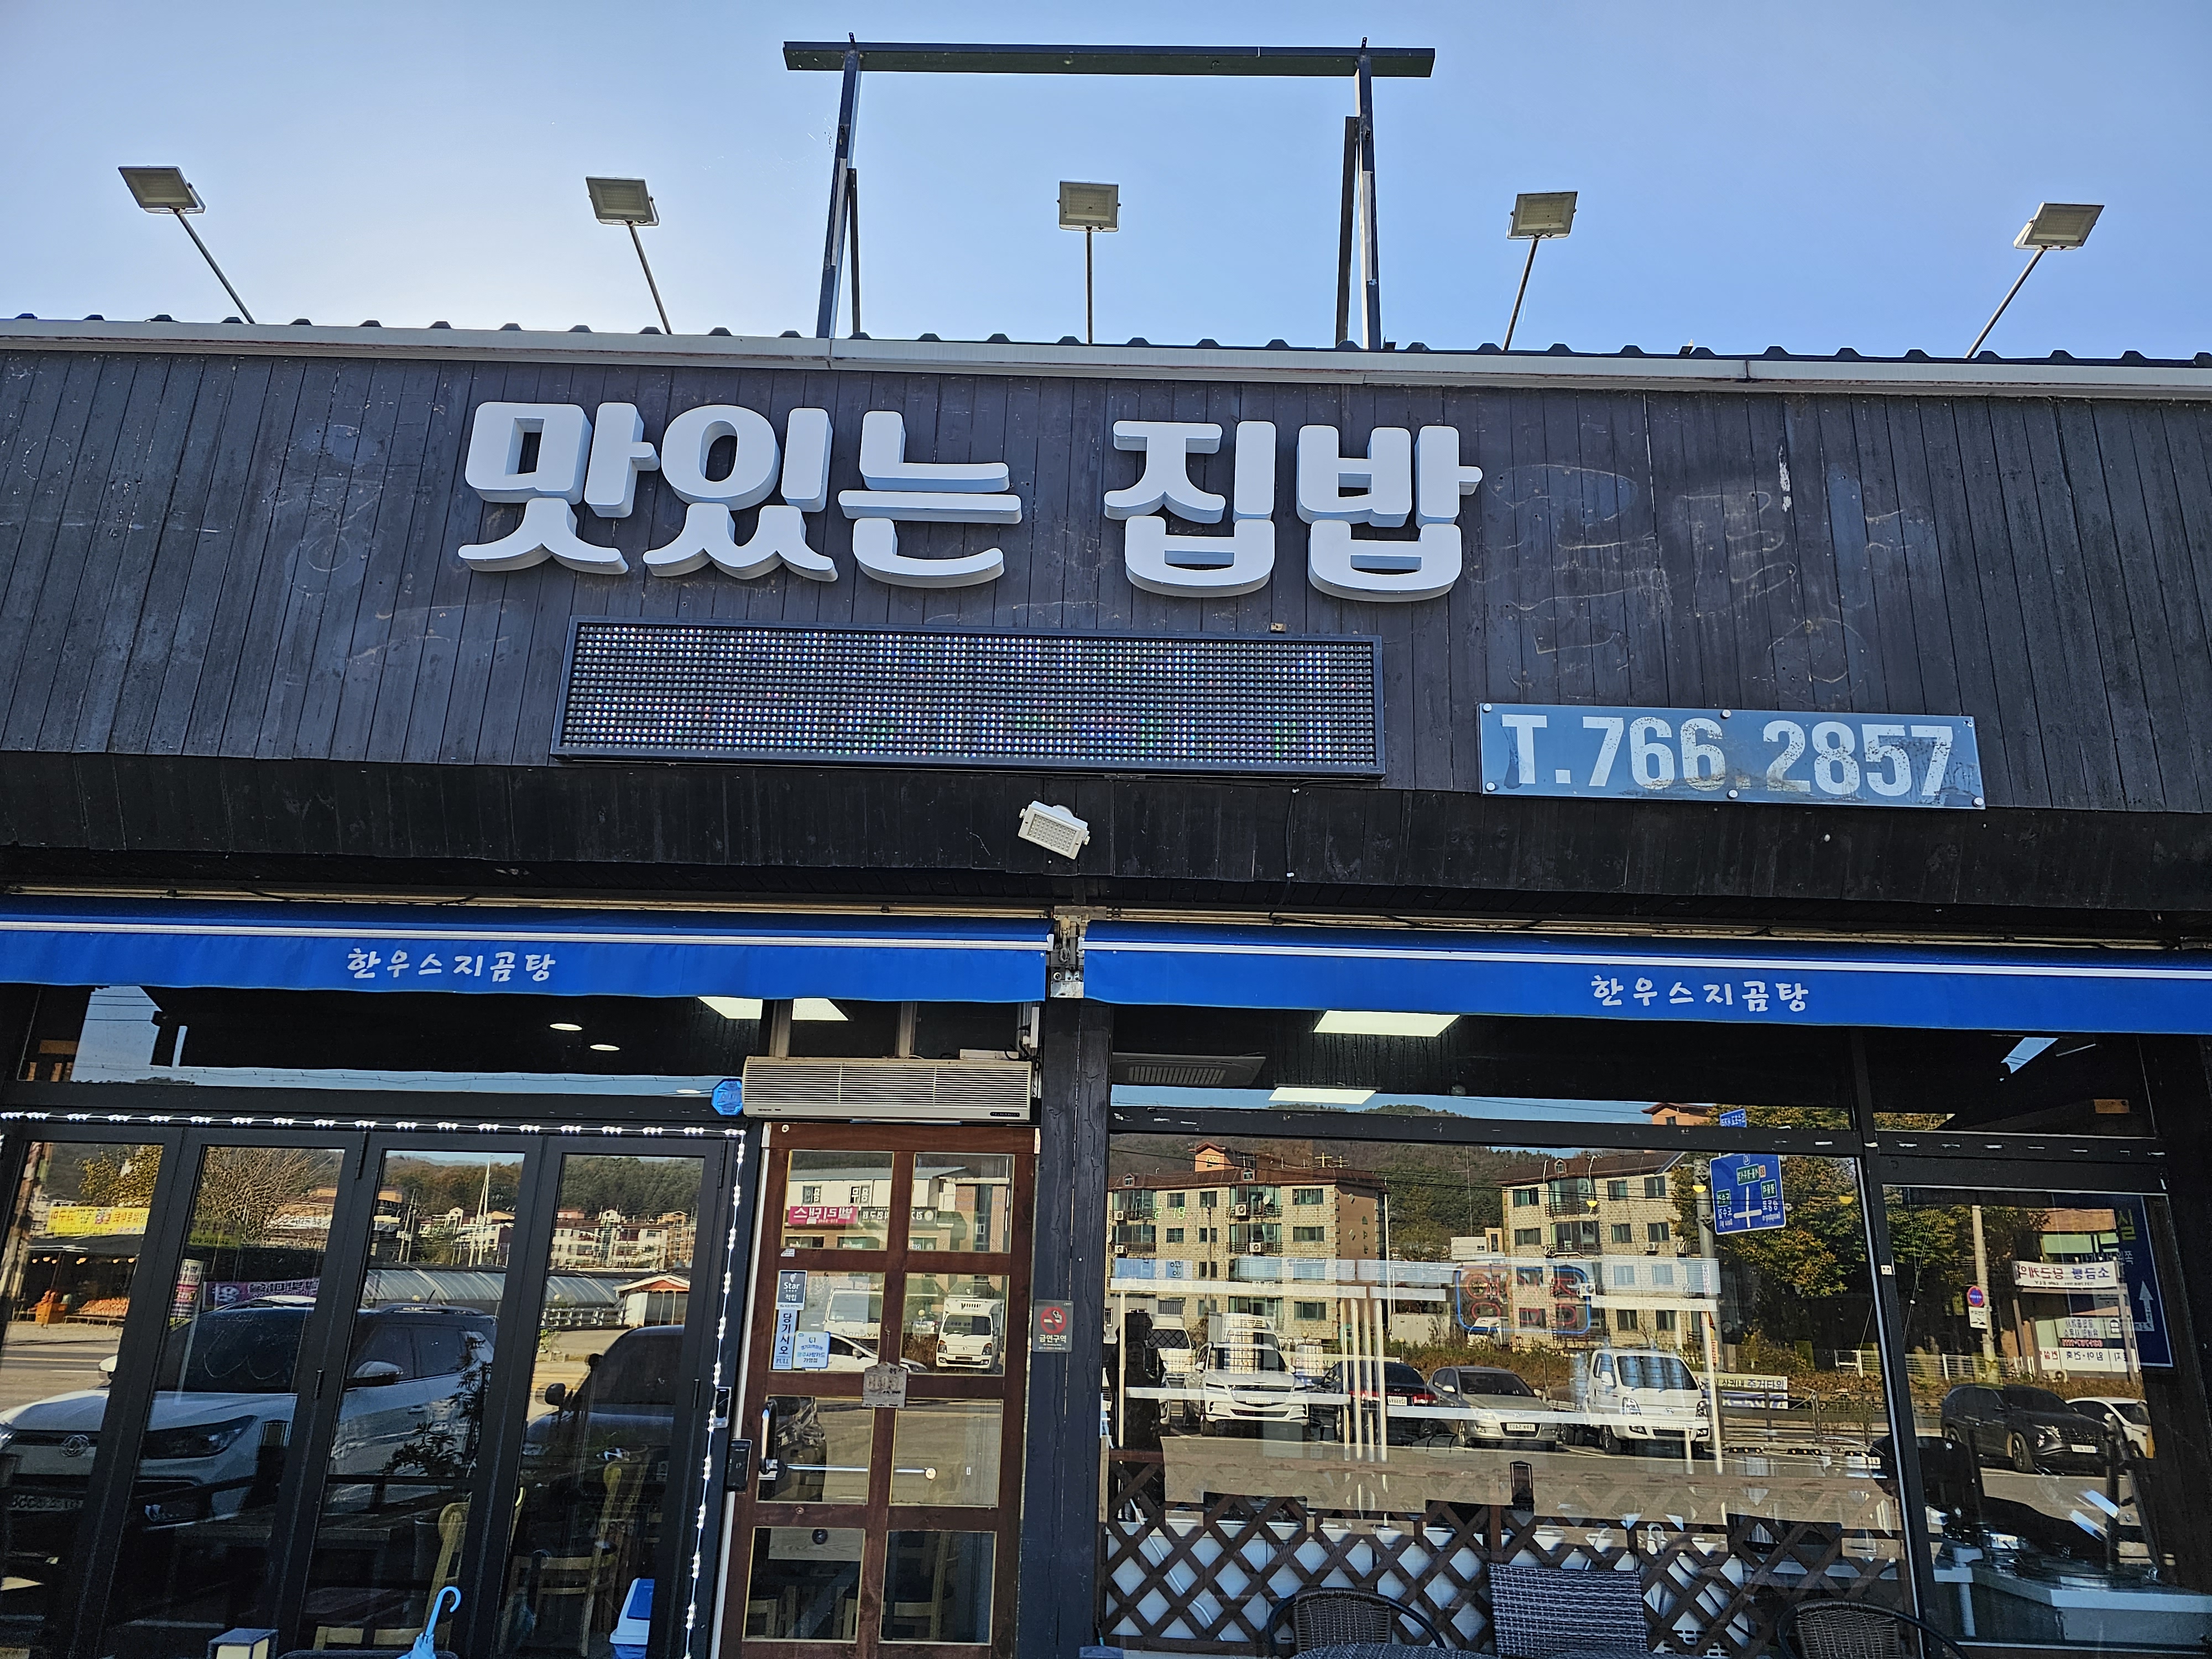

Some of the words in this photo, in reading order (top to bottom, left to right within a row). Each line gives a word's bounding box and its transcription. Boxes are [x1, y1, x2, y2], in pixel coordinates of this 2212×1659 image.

[457, 400, 1025, 583] 맛있는
[1104, 418, 1484, 602] 집밥
[347, 948, 555, 982] 한우스지곰탕
[1591, 975, 1809, 1012] 한우스지곰탕
[779, 1313, 792, 1354] 당기시오
[1039, 1334, 1067, 1343] 금연구역
[866, 1375, 904, 1391] CLOSE
